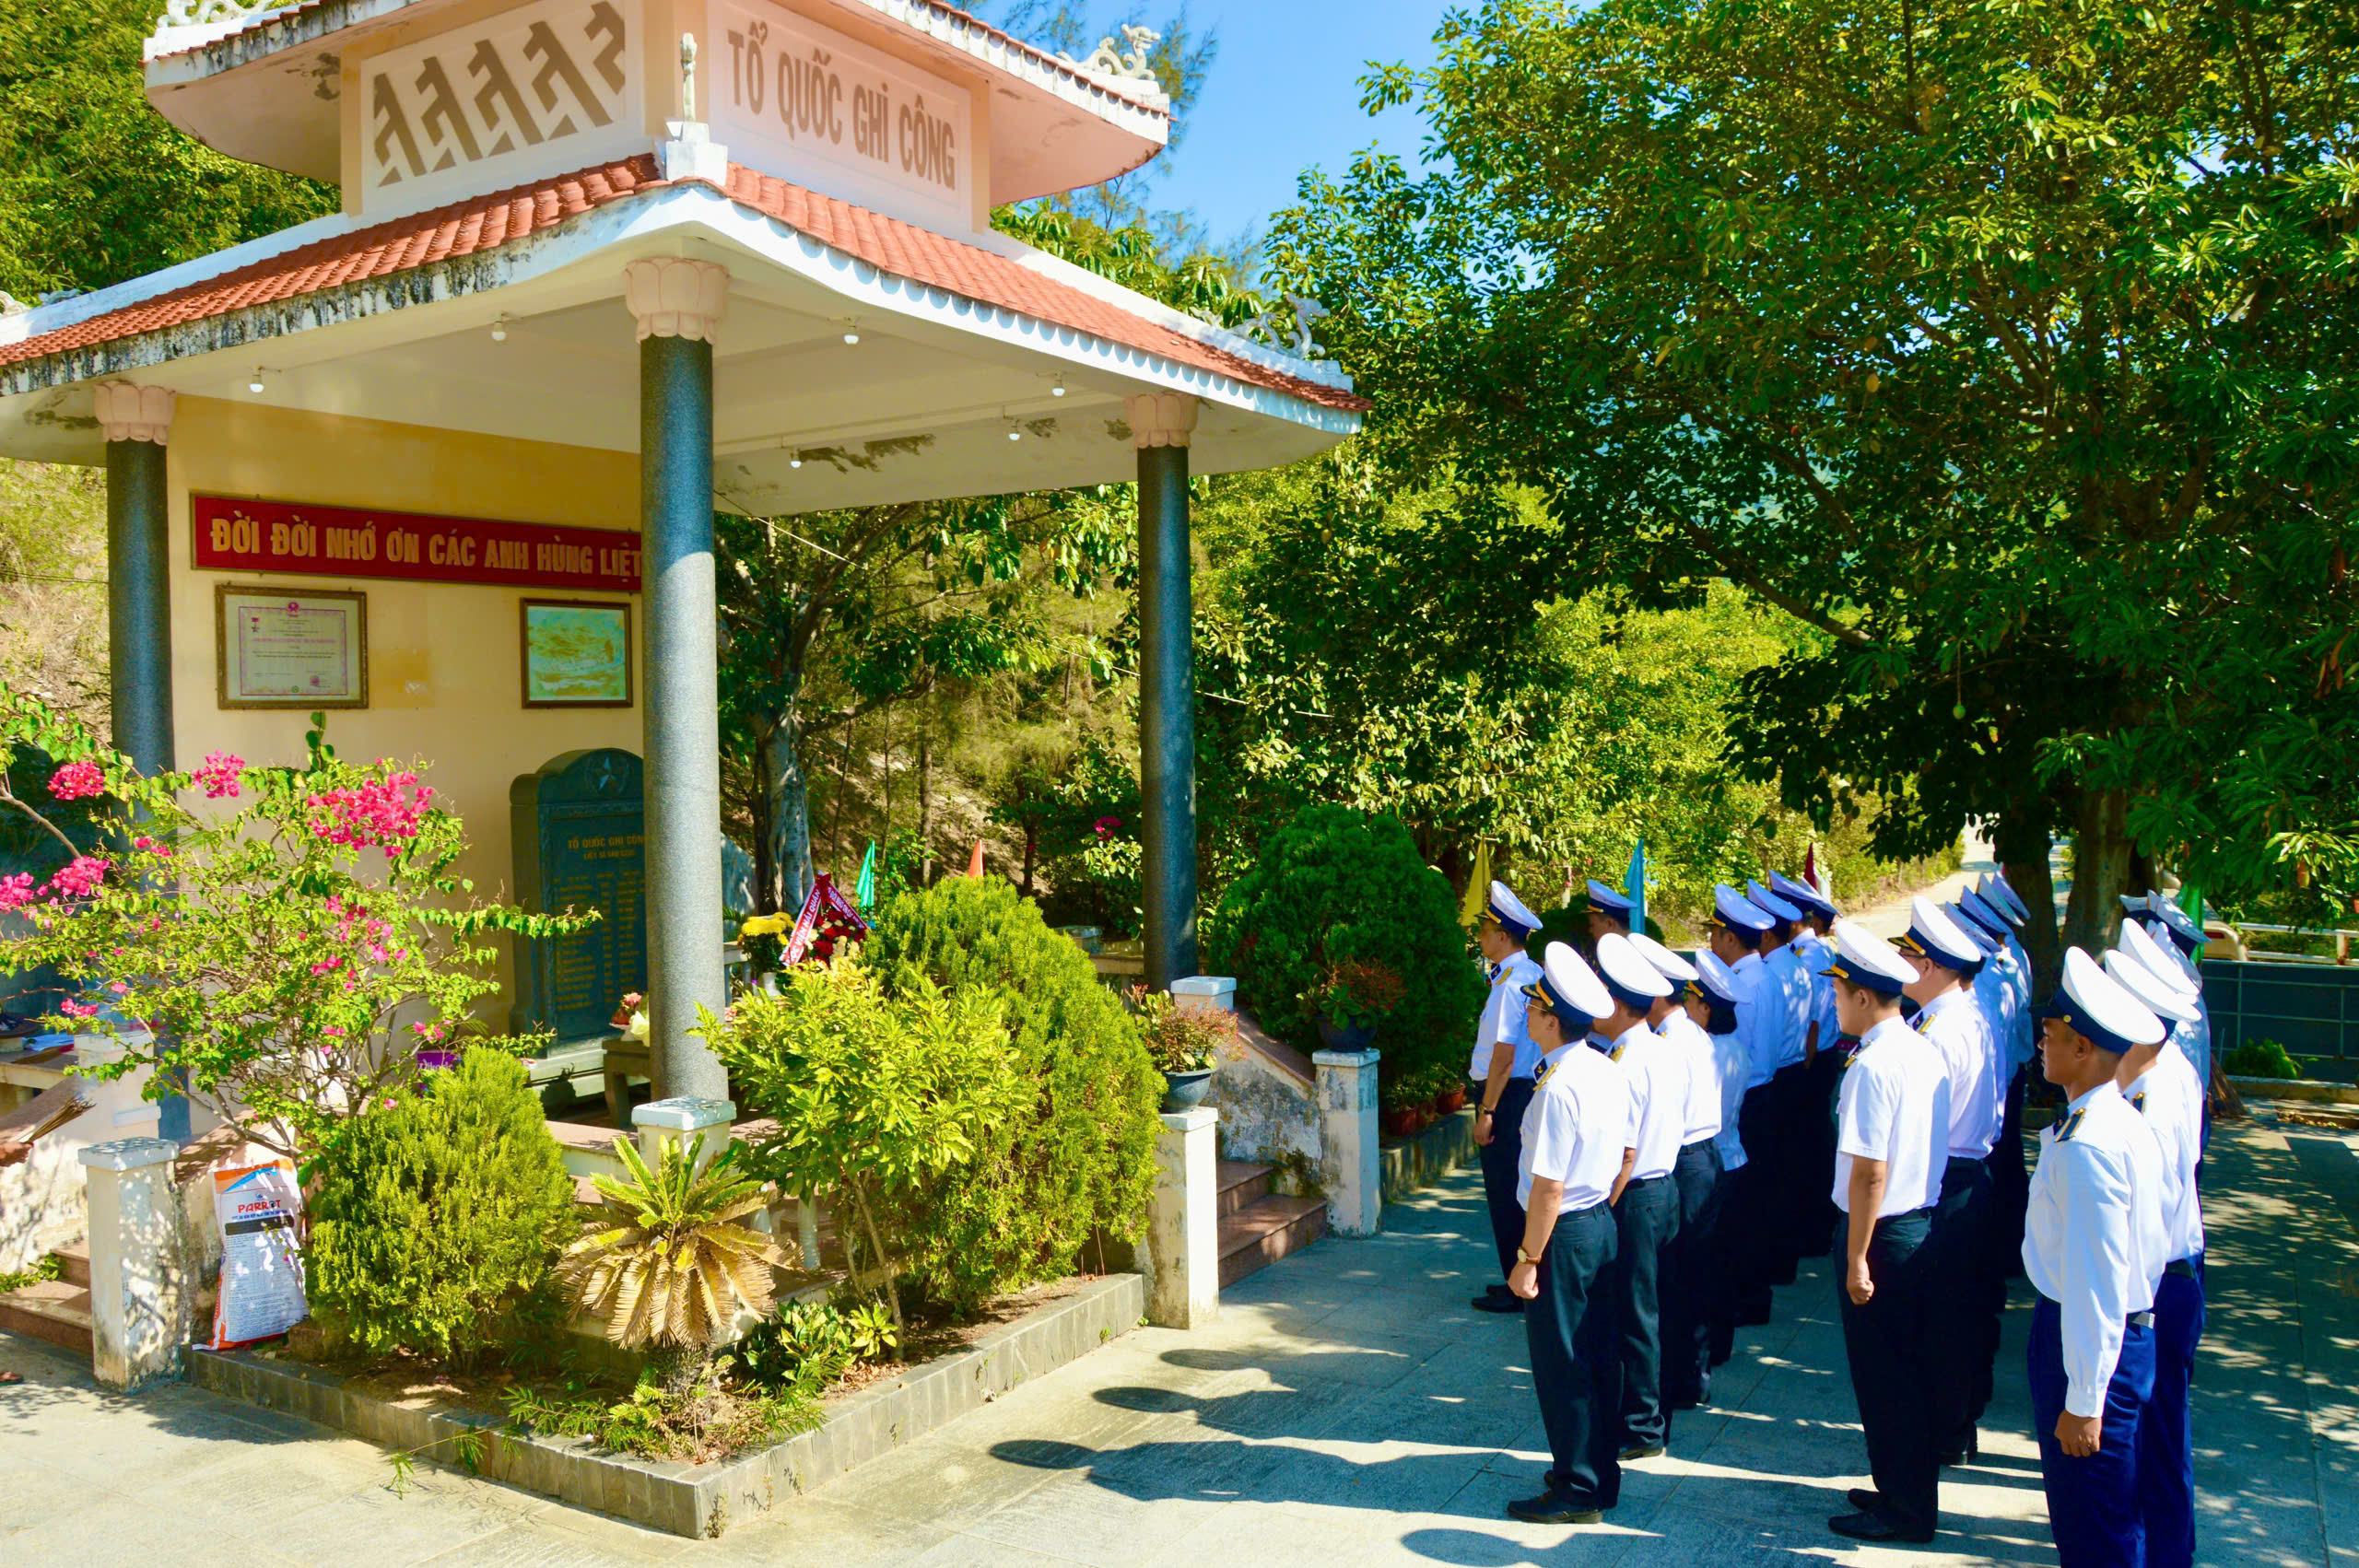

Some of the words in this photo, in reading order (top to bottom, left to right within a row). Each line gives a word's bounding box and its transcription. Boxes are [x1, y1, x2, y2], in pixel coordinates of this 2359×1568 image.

[727, 21, 769, 115] TỔ
[777, 48, 843, 146] QUỐC
[898, 94, 956, 191] CÔNG
[209, 509, 260, 554] ĐỜI
[270, 514, 317, 557] ĐỜI
[325, 521, 377, 561] NHỚ
[386, 526, 420, 564] ƠN
[428, 528, 476, 567] CÁC
[485, 538, 530, 570] ANH
[536, 534, 593, 575] HÙNG
[599, 542, 643, 583] LIỆT
[237, 1199, 281, 1213] PARROT
